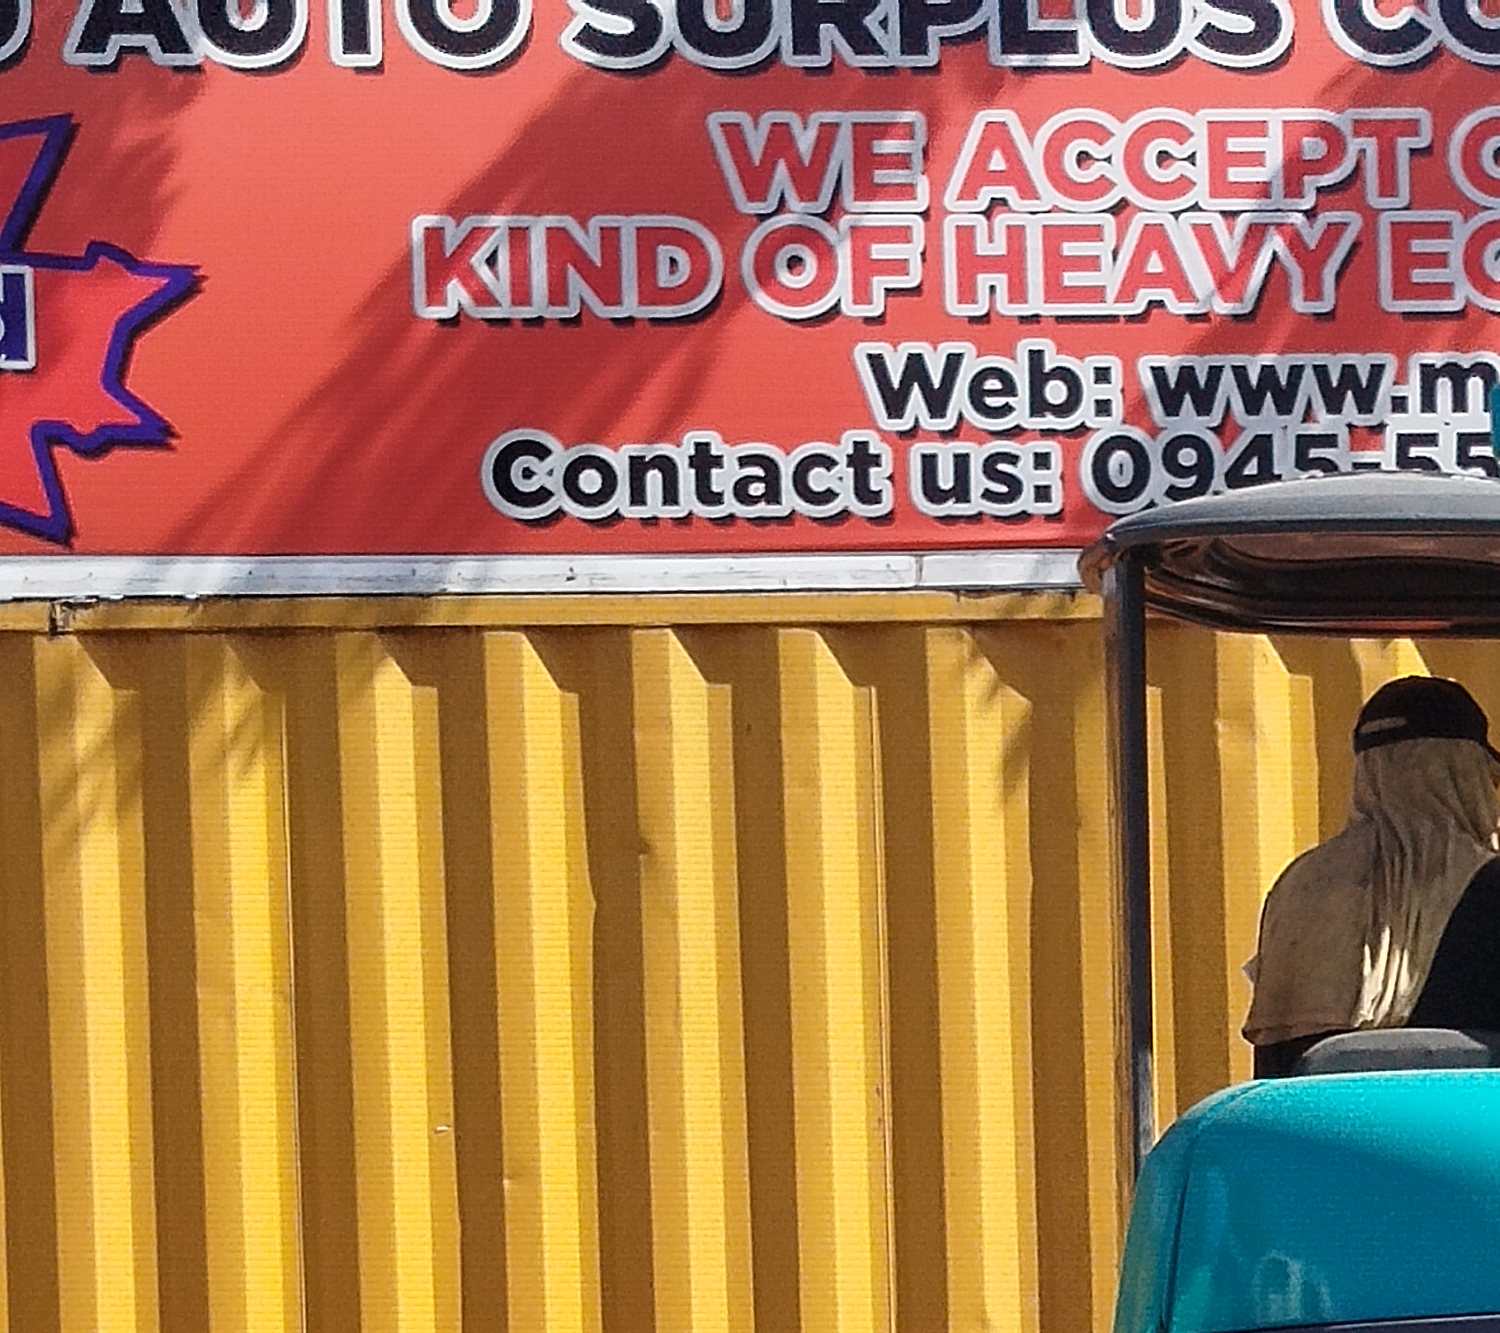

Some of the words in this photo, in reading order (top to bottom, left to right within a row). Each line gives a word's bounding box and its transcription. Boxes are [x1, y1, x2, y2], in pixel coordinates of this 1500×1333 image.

[707, 110, 928, 213] WE
[944, 108, 1431, 211] ACCEPT
[412, 215, 723, 320] KIND
[742, 213, 923, 319] OF
[943, 212, 1360, 315] HEAVY
[854, 340, 1121, 432] Web:
[481, 428, 892, 520] Contact
[910, 440, 1062, 518] us:
